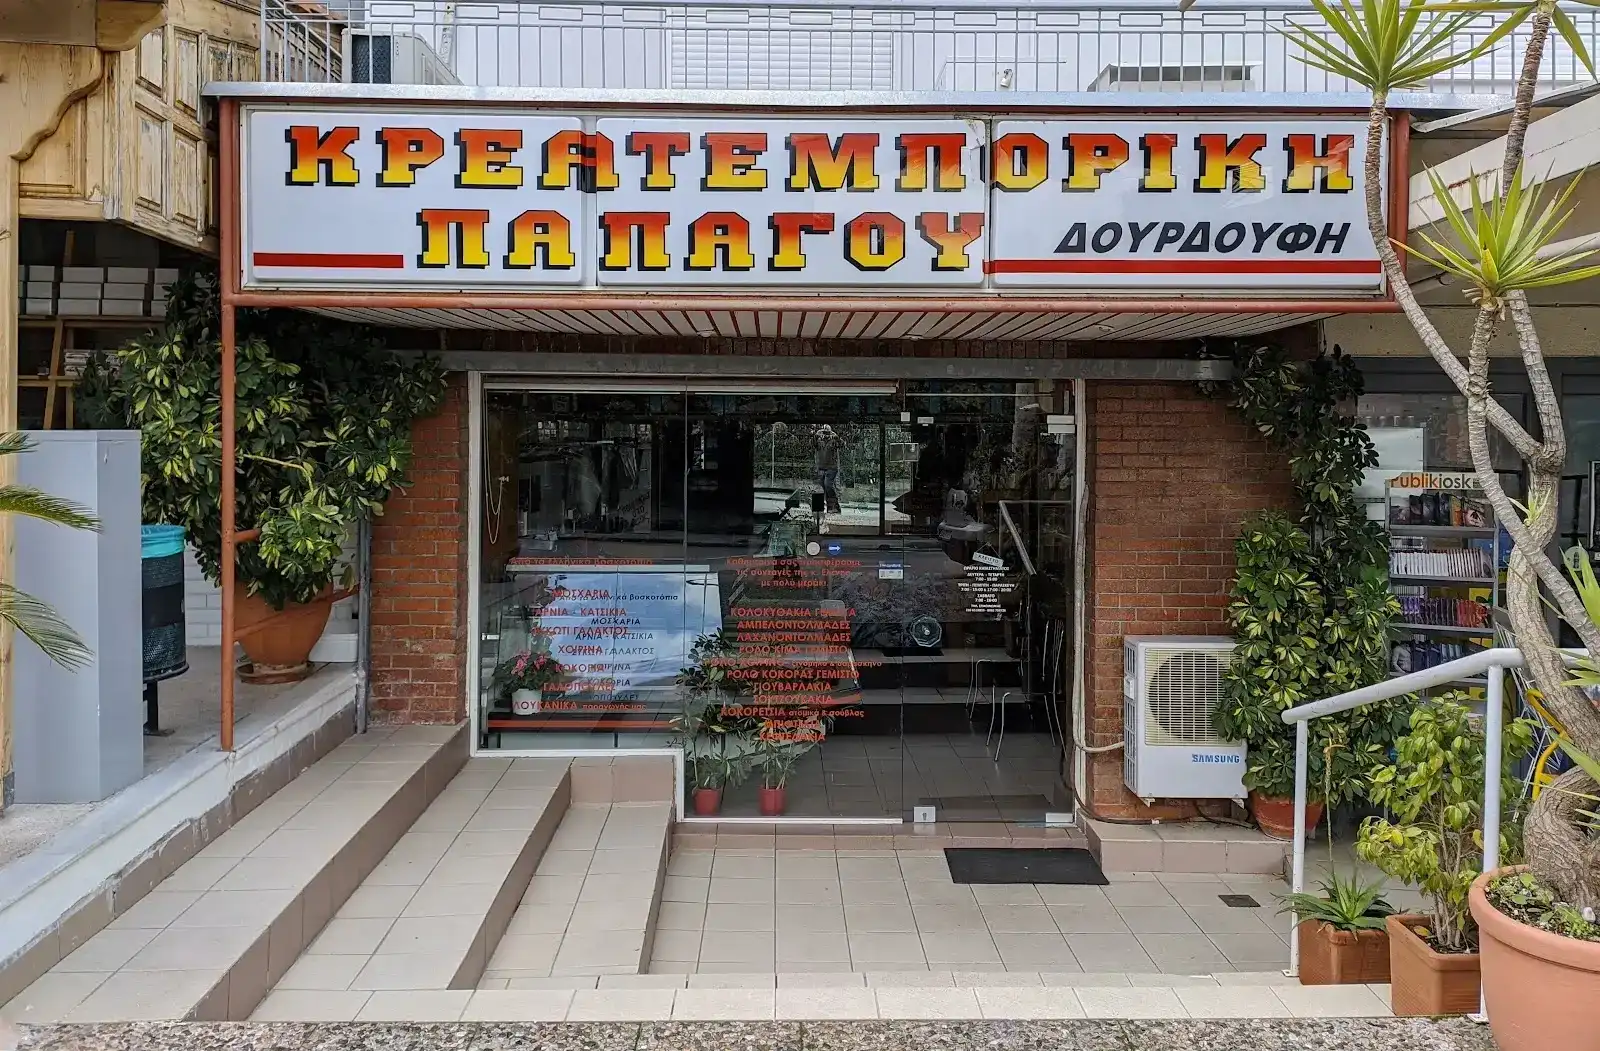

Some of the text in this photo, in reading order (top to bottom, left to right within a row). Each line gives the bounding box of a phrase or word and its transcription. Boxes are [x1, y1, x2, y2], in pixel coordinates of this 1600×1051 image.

[285, 125, 1355, 194] ΚΡΕΑΤΕΜΠΟΡΙΚΗ
[416, 208, 985, 272] ΠΑΠΑΓΟΥ
[1053, 221, 1351, 254] ΔΟΥΡΔΟΥΦΗ
[552, 589, 610, 598] ΜΟΣΧΑΡΙΑ
[534, 607, 569, 616] ΑΡΝΙΑ
[580, 607, 627, 616] ΚΑΤΣΙΚΙΑ
[730, 608, 811, 617] ΚΟΛΟΚΥΘΑΚΙΑ
[737, 621, 851, 630] ΑΜΠΕΛΟΝΤΟΛΜΑΔΕΣ
[531, 626, 629, 636] ΚΩΤΙ ΓΑΛΑΚΤΟΣ
[736, 633, 851, 642] ΛΑΧΑΝΟΝΤΟΛΜΑΔΕΣ
[727, 670, 860, 679] ΡΟΛΟ ΚΟΚΟΡΑΣ ΓΕΜΙΣΤΟ
[754, 683, 832, 692] ΓΙΟΥΒΑΡΛΑΚΙΑ
[754, 695, 833, 704] ΣΟΥΤΖΟΥΚΑΚΙΑ
[513, 701, 578, 710] ΛΟΥΚΑΝΙΚΑ
[721, 708, 785, 717] ΚΟΚΟΡΕΤΣΙΑ
[829, 708, 865, 719] σούβλας
[1192, 754, 1240, 764] SAMSUNG
